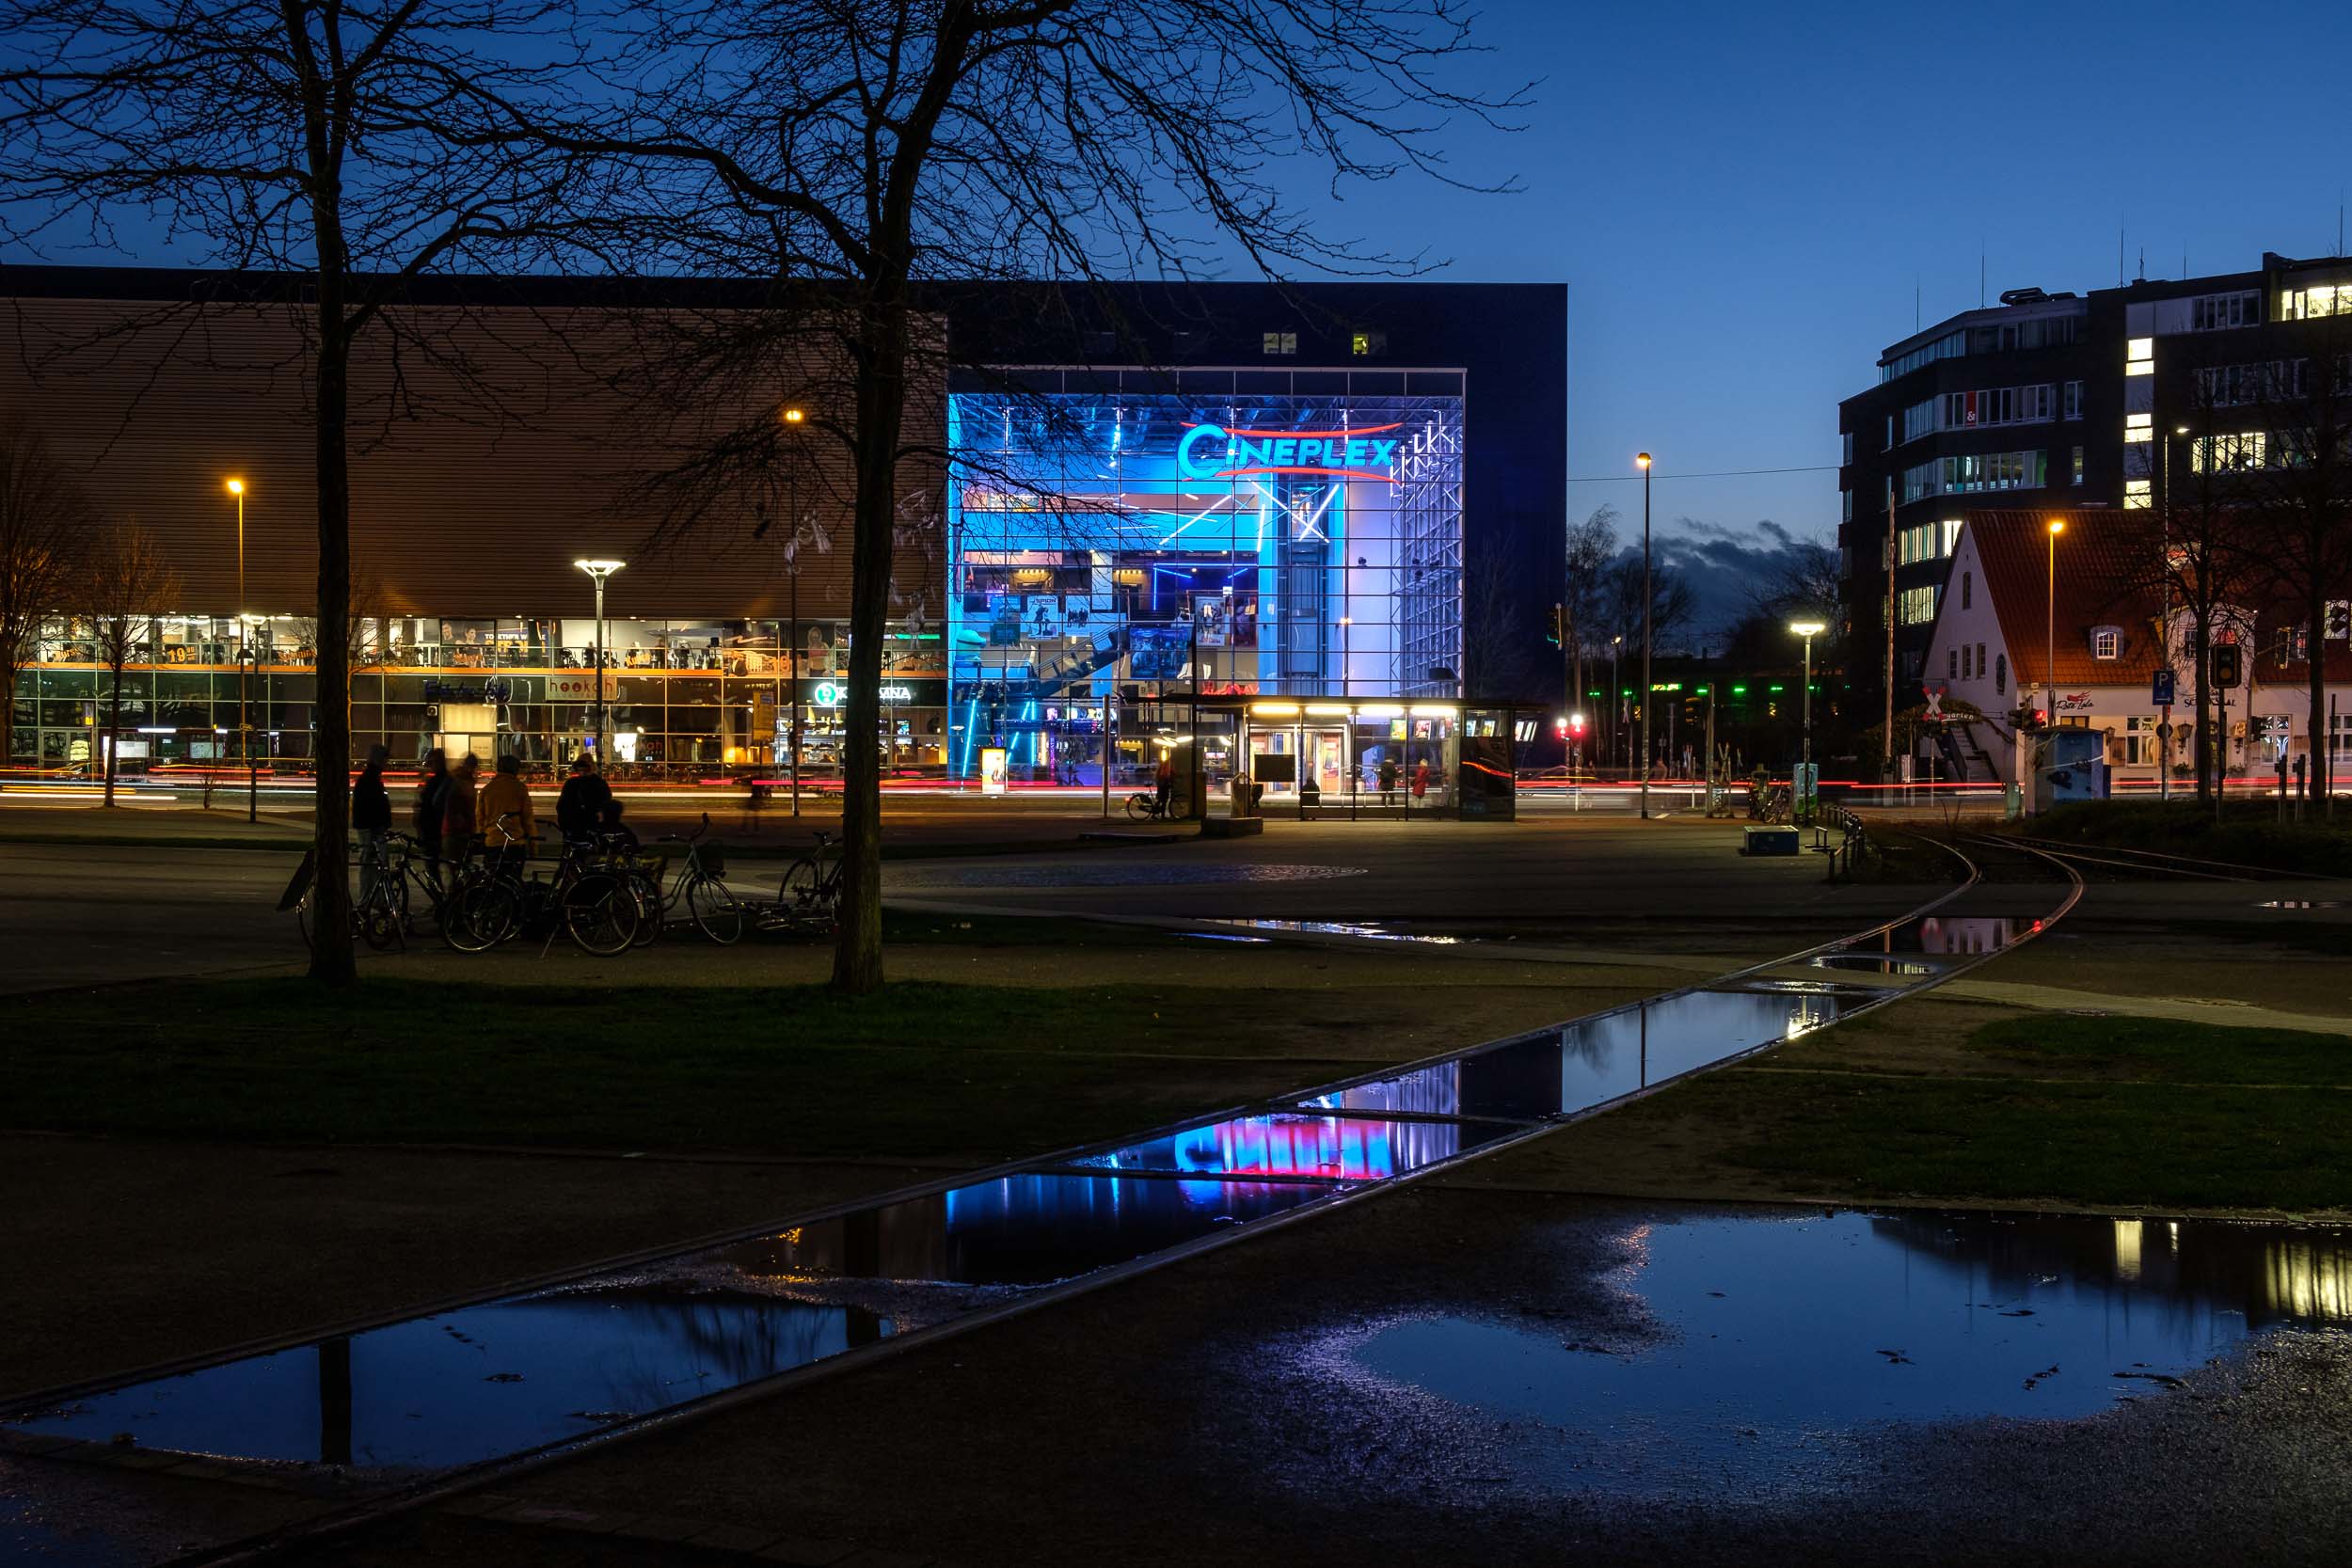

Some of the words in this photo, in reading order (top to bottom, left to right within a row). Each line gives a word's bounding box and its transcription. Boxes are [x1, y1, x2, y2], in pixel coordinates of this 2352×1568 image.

[1966, 411, 1976, 421] &
[1178, 423, 1397, 480] CINEPLEX
[2158, 673, 2169, 687] P
